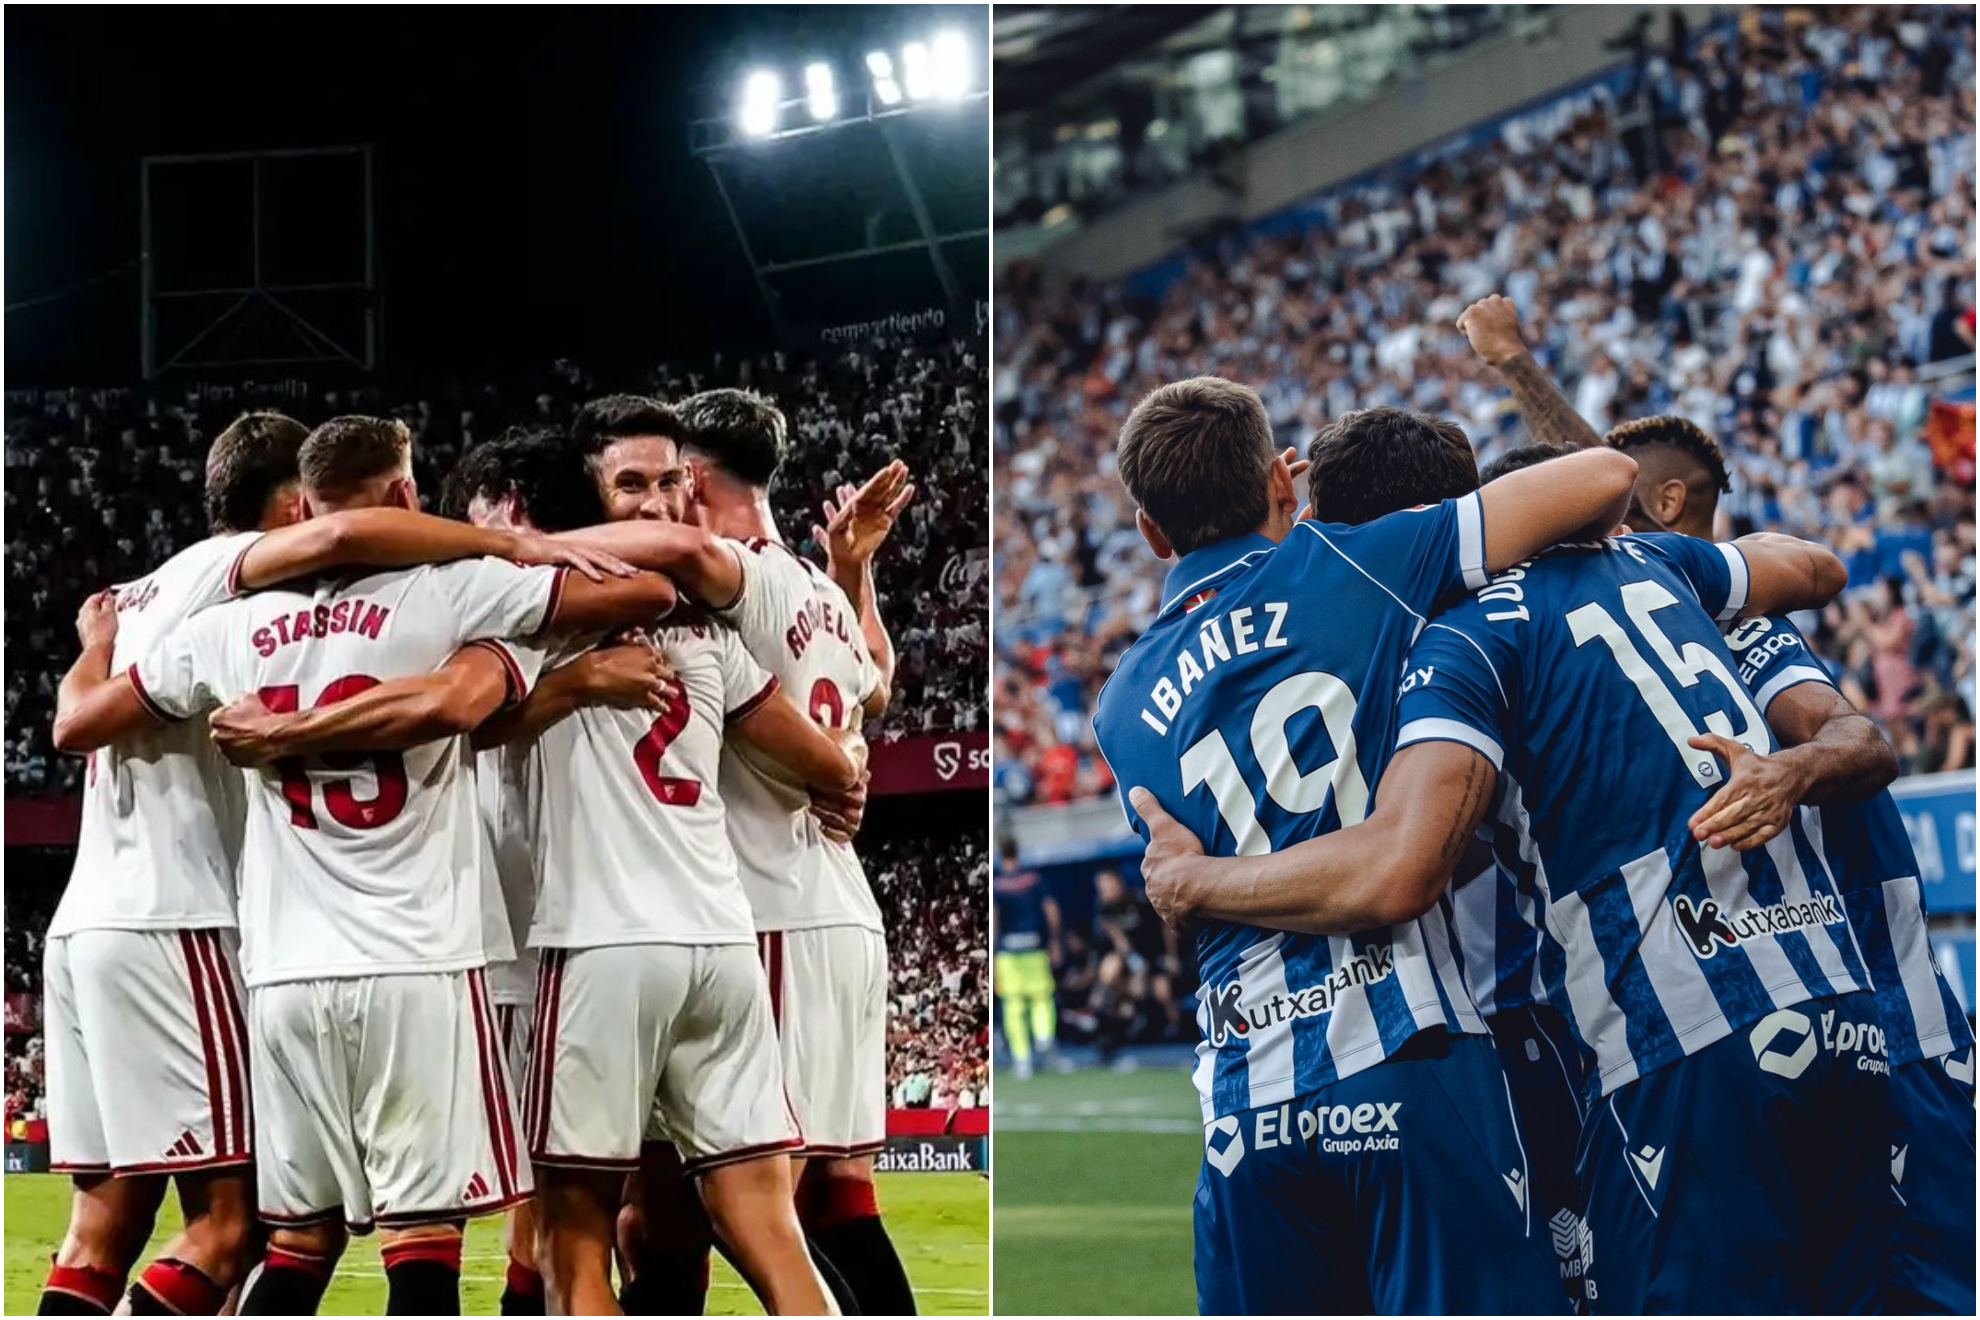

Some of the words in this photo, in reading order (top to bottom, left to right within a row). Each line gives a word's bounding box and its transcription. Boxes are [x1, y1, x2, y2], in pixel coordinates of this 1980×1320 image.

[251, 599, 390, 658] STASSIN
[1140, 601, 1289, 737] IBAÑEZ
[1564, 579, 1771, 790] 15
[633, 677, 702, 807] 2
[1179, 670, 1370, 857] 19
[1675, 891, 1843, 958] Kutxabank
[874, 1142, 972, 1170] aixaBank
[1322, 1137, 1362, 1155] Grupo
[1363, 1134, 1400, 1151] Axia
